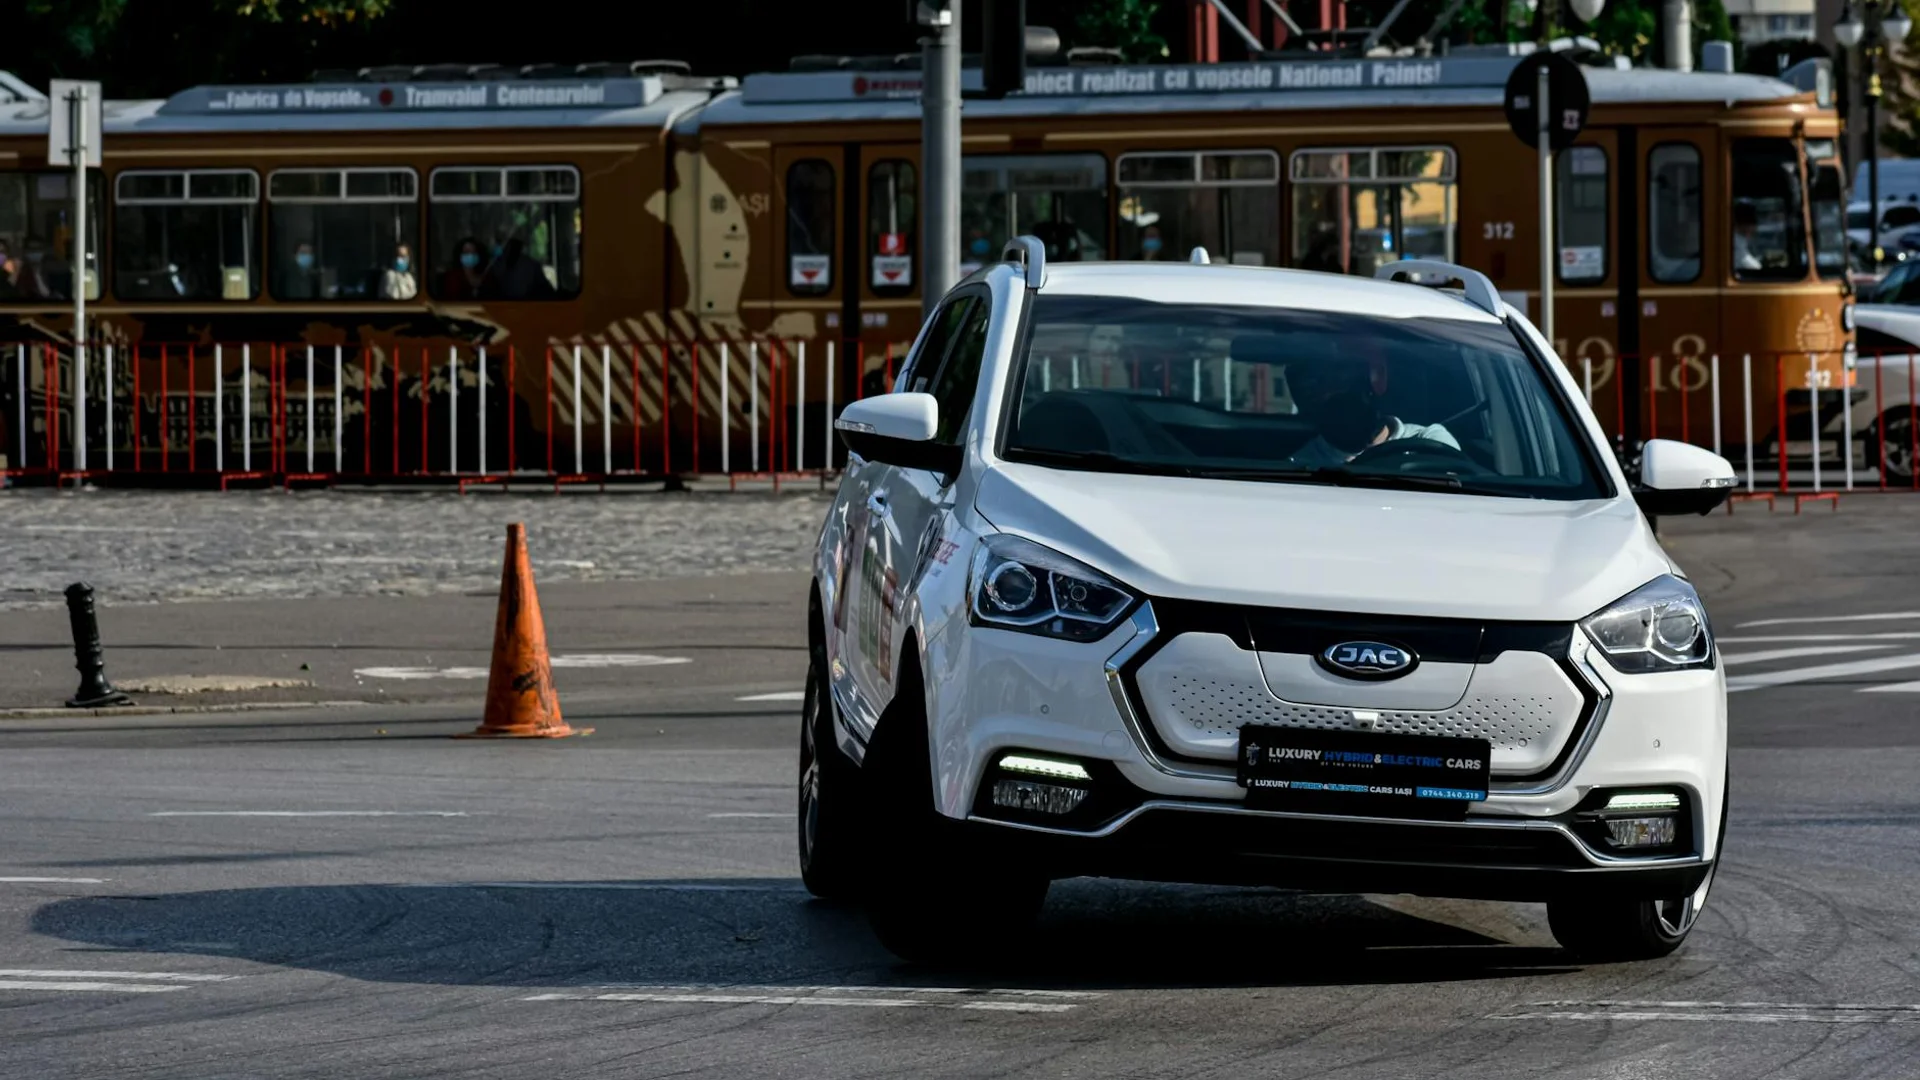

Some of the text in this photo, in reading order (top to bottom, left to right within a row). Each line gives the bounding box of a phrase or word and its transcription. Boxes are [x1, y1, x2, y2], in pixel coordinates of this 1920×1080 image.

[1024, 69, 1074, 94] oiect
[1082, 67, 1155, 92] realizat
[1163, 68, 1189, 88] cu
[1280, 62, 1362, 87] National
[405, 85, 487, 107] Tramvaiul
[1483, 222, 1515, 239] 312
[1338, 647, 1398, 665] JAC
[1268, 747, 1322, 760] LUXURY
[1446, 757, 1482, 770] CARS
[1255, 779, 1290, 789] LUXURY
[1369, 786, 1393, 795] CARS
